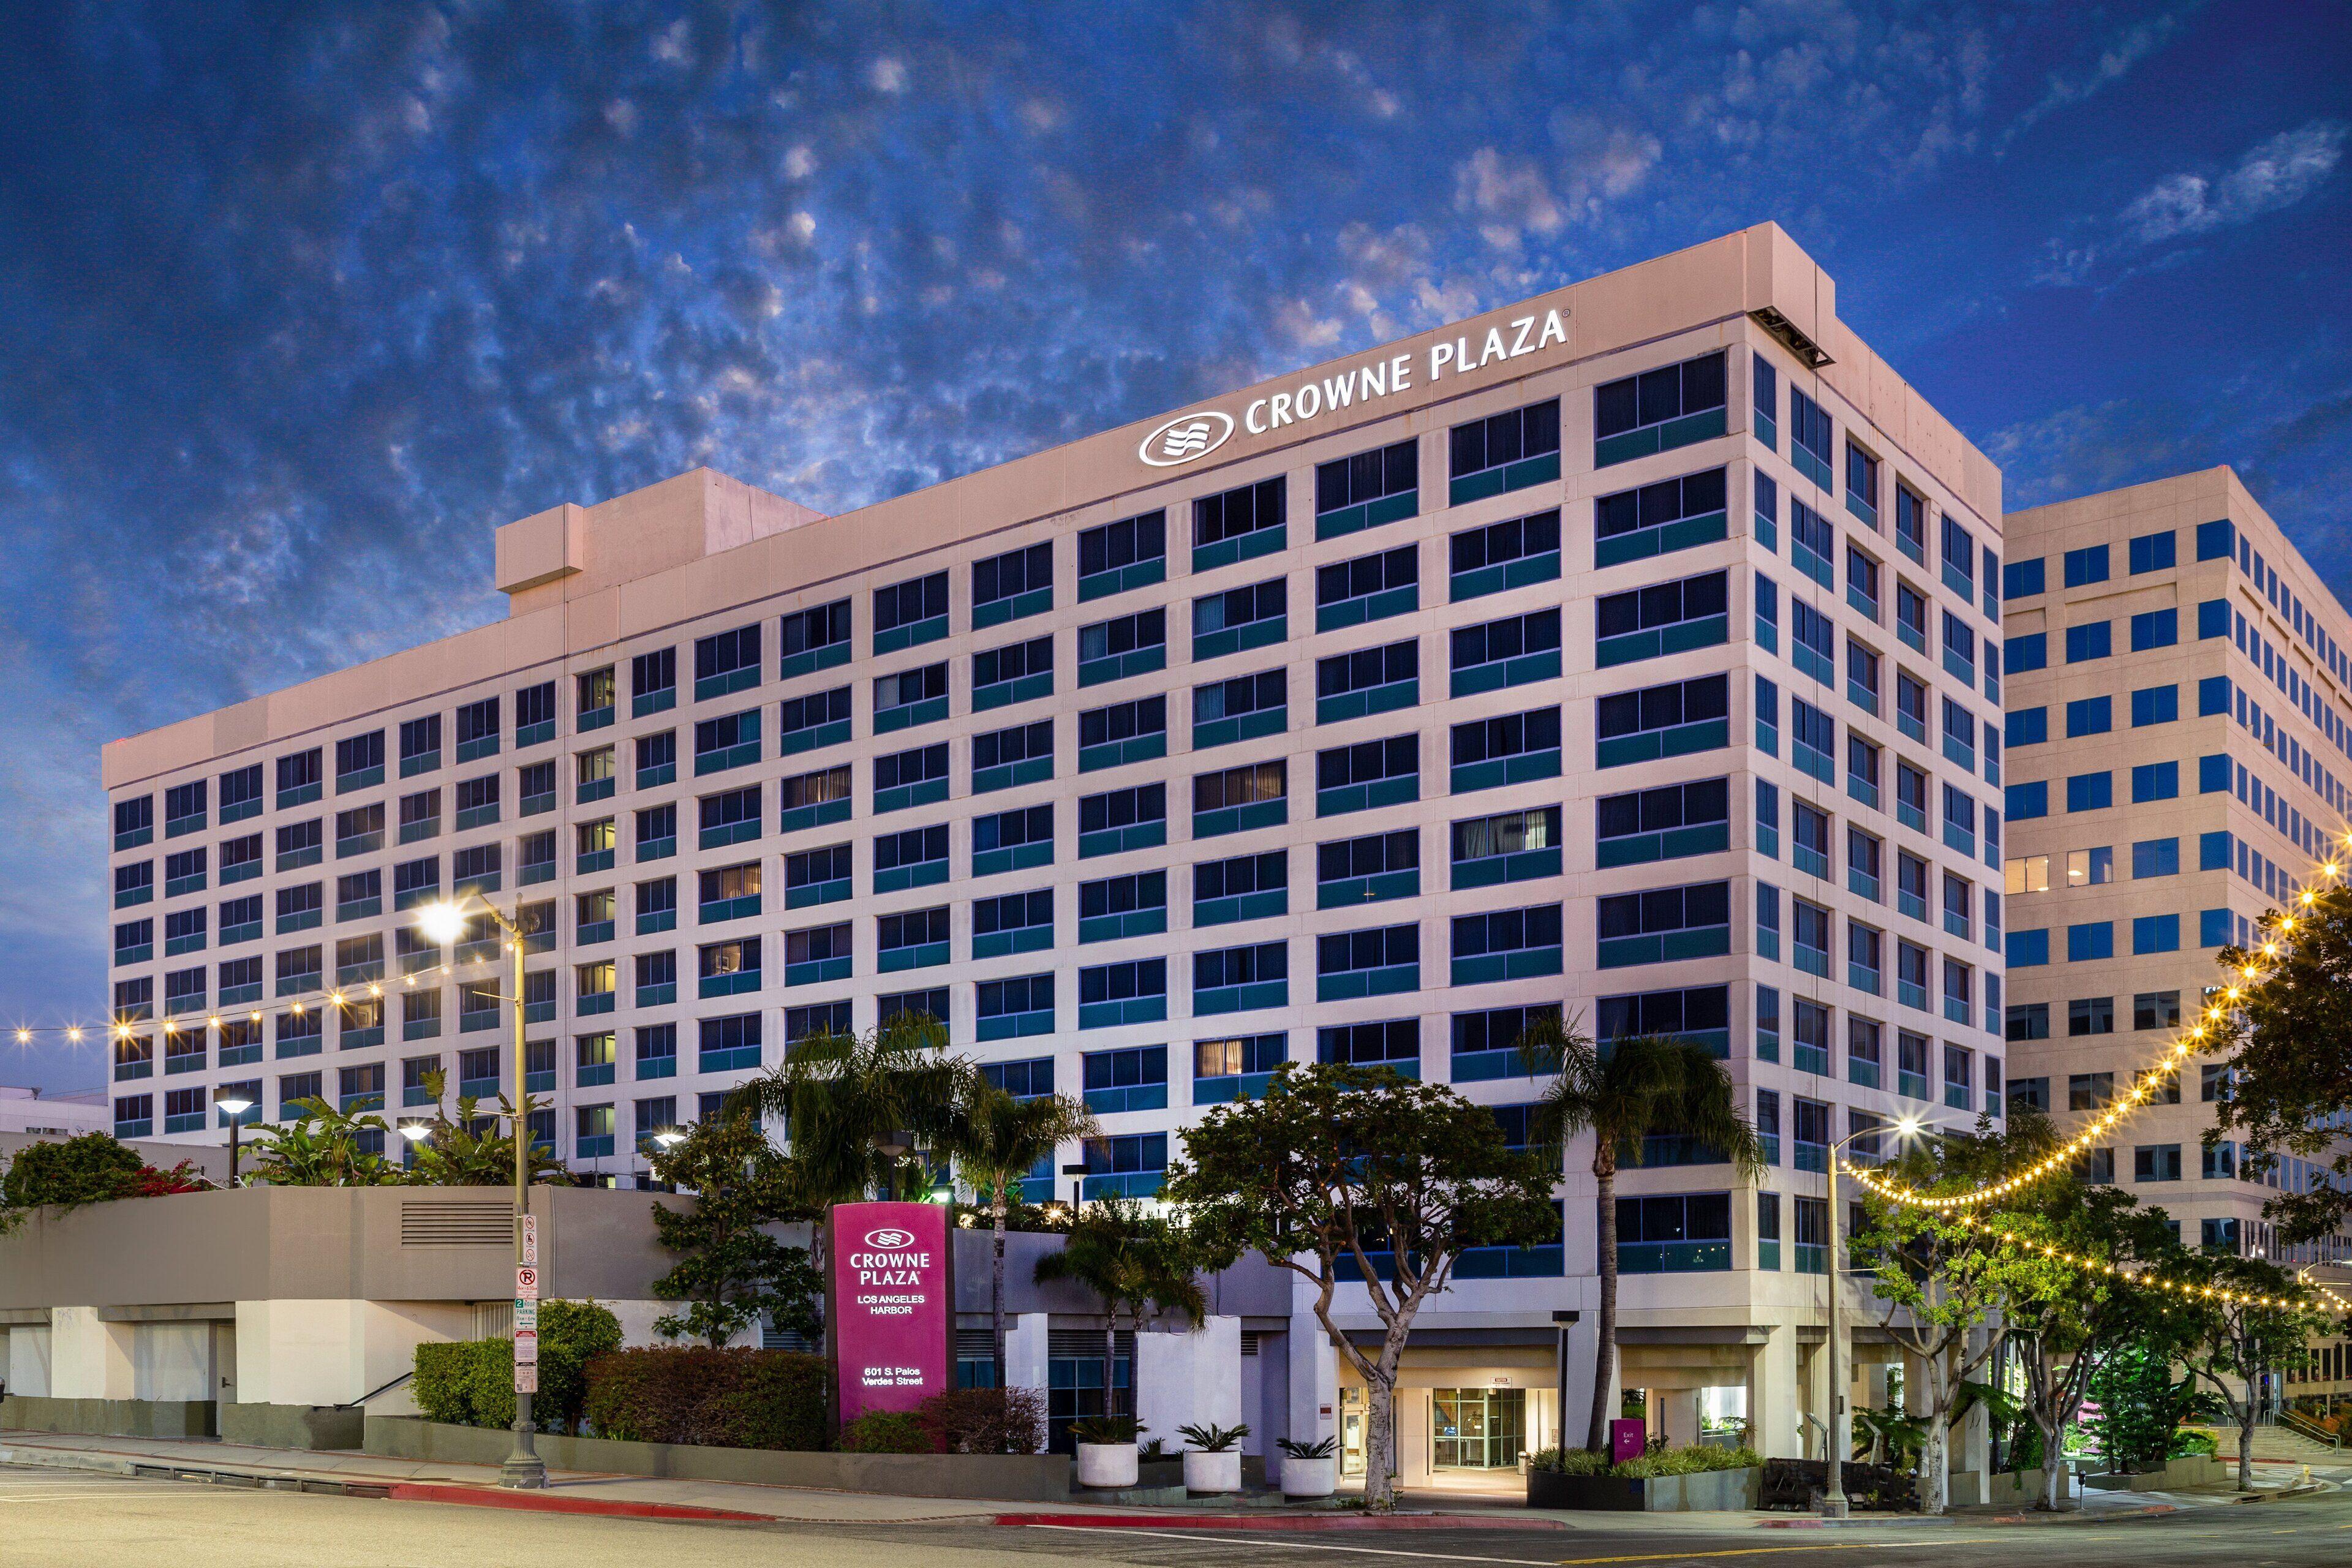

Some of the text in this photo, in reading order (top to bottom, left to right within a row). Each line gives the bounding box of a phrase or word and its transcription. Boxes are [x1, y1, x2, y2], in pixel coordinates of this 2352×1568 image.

[1245, 309, 1567, 434] CROWNE PLAZA
[850, 1253, 930, 1268] CROWNE
[860, 1270, 920, 1285] PLAZA
[858, 1295, 925, 1304] LOS ANGELES
[870, 1306, 913, 1314] HARBOR
[864, 1367, 921, 1376] 601 S. Palos
[862, 1377, 894, 1385] Verdes
